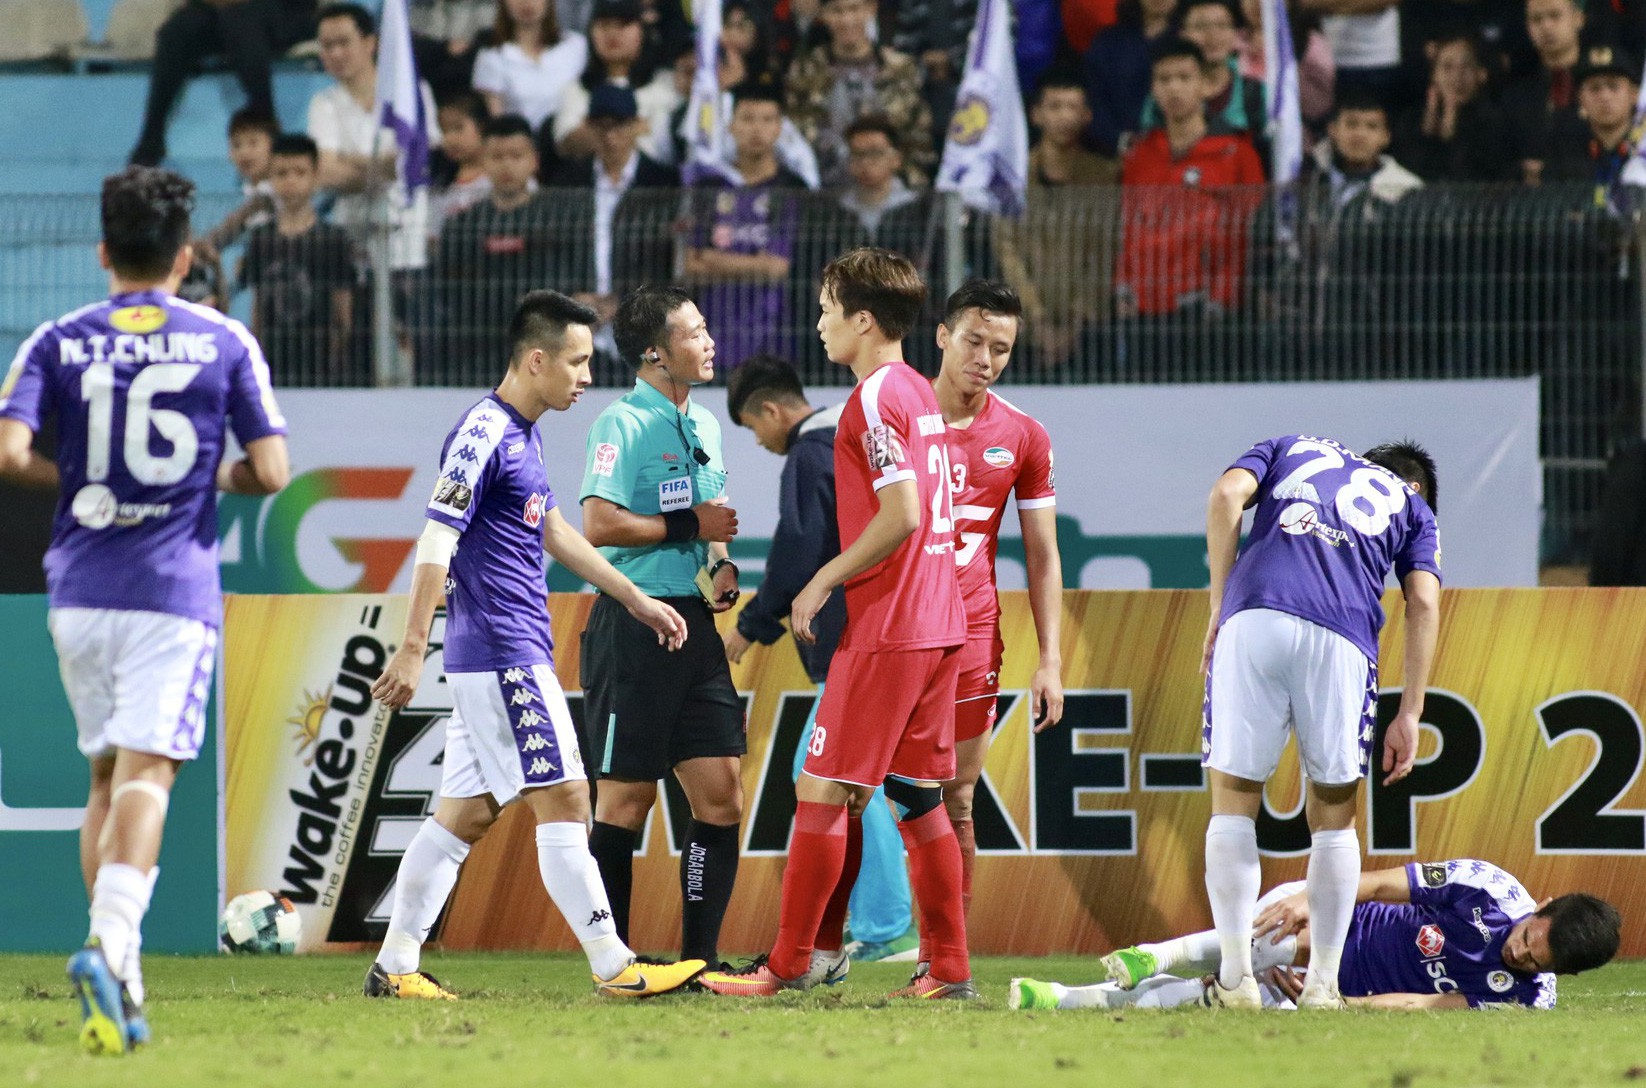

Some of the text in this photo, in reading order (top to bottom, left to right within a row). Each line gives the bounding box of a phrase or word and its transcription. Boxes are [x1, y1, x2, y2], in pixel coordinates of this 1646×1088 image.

[81, 362, 203, 486] 16
[594, 464, 612, 473] VPF
[661, 480, 689, 494] FIFA
[661, 496, 690, 506] REFEREE
[927, 443, 956, 534] 2
[1273, 440, 1406, 536] 78
[320, 701, 388, 909] the coffee innovato
[687, 842, 707, 901] JOGARBOLA
